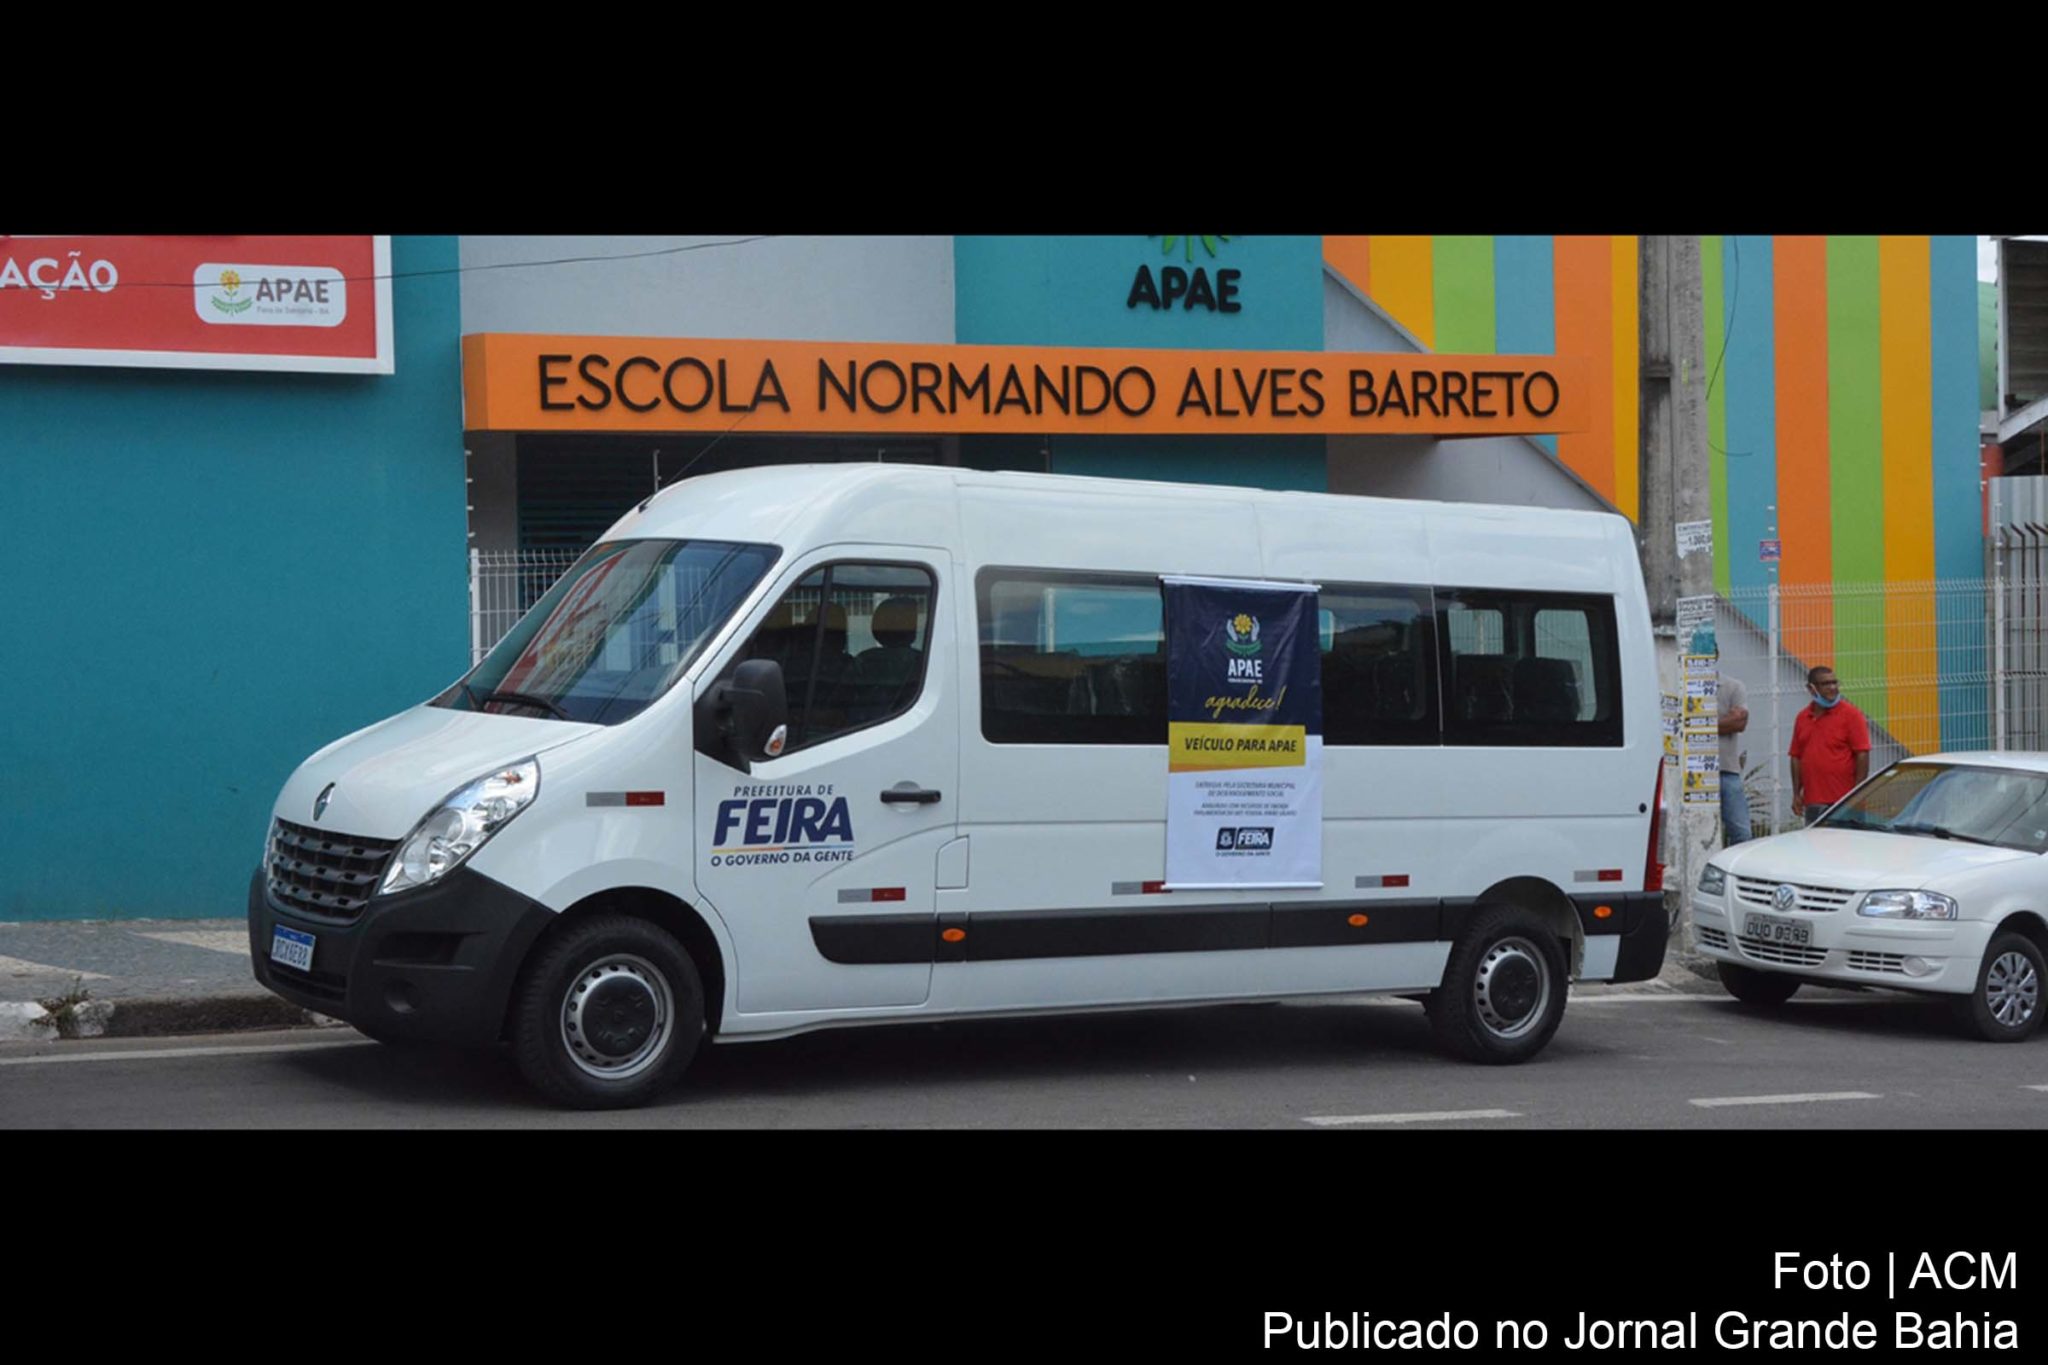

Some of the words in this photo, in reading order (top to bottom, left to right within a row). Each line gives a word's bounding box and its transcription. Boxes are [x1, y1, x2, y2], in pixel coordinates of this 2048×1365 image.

[256, 278, 329, 304] APAE
[1127, 264, 1242, 313] APAE
[538, 354, 790, 414] ESCOLA
[818, 358, 1156, 417] NORMANDO
[1176, 367, 1325, 417] ALVES
[1349, 369, 1560, 417] BARRETO
[1228, 658, 1263, 677] APAE
[1205, 684, 1287, 719] agradece!
[1184, 734, 1233, 751] VEÍCULO
[1236, 738, 1267, 751] PARA
[1269, 739, 1298, 752] APAE
[733, 785, 812, 798] PREFEITURA
[817, 784, 834, 796] DE
[712, 796, 854, 847] FEIRA
[1238, 831, 1270, 846] FEIRA
[711, 855, 722, 867] O
[725, 852, 789, 867] GOVERNO
[793, 851, 811, 864] DA
[814, 850, 854, 862] GENTE
